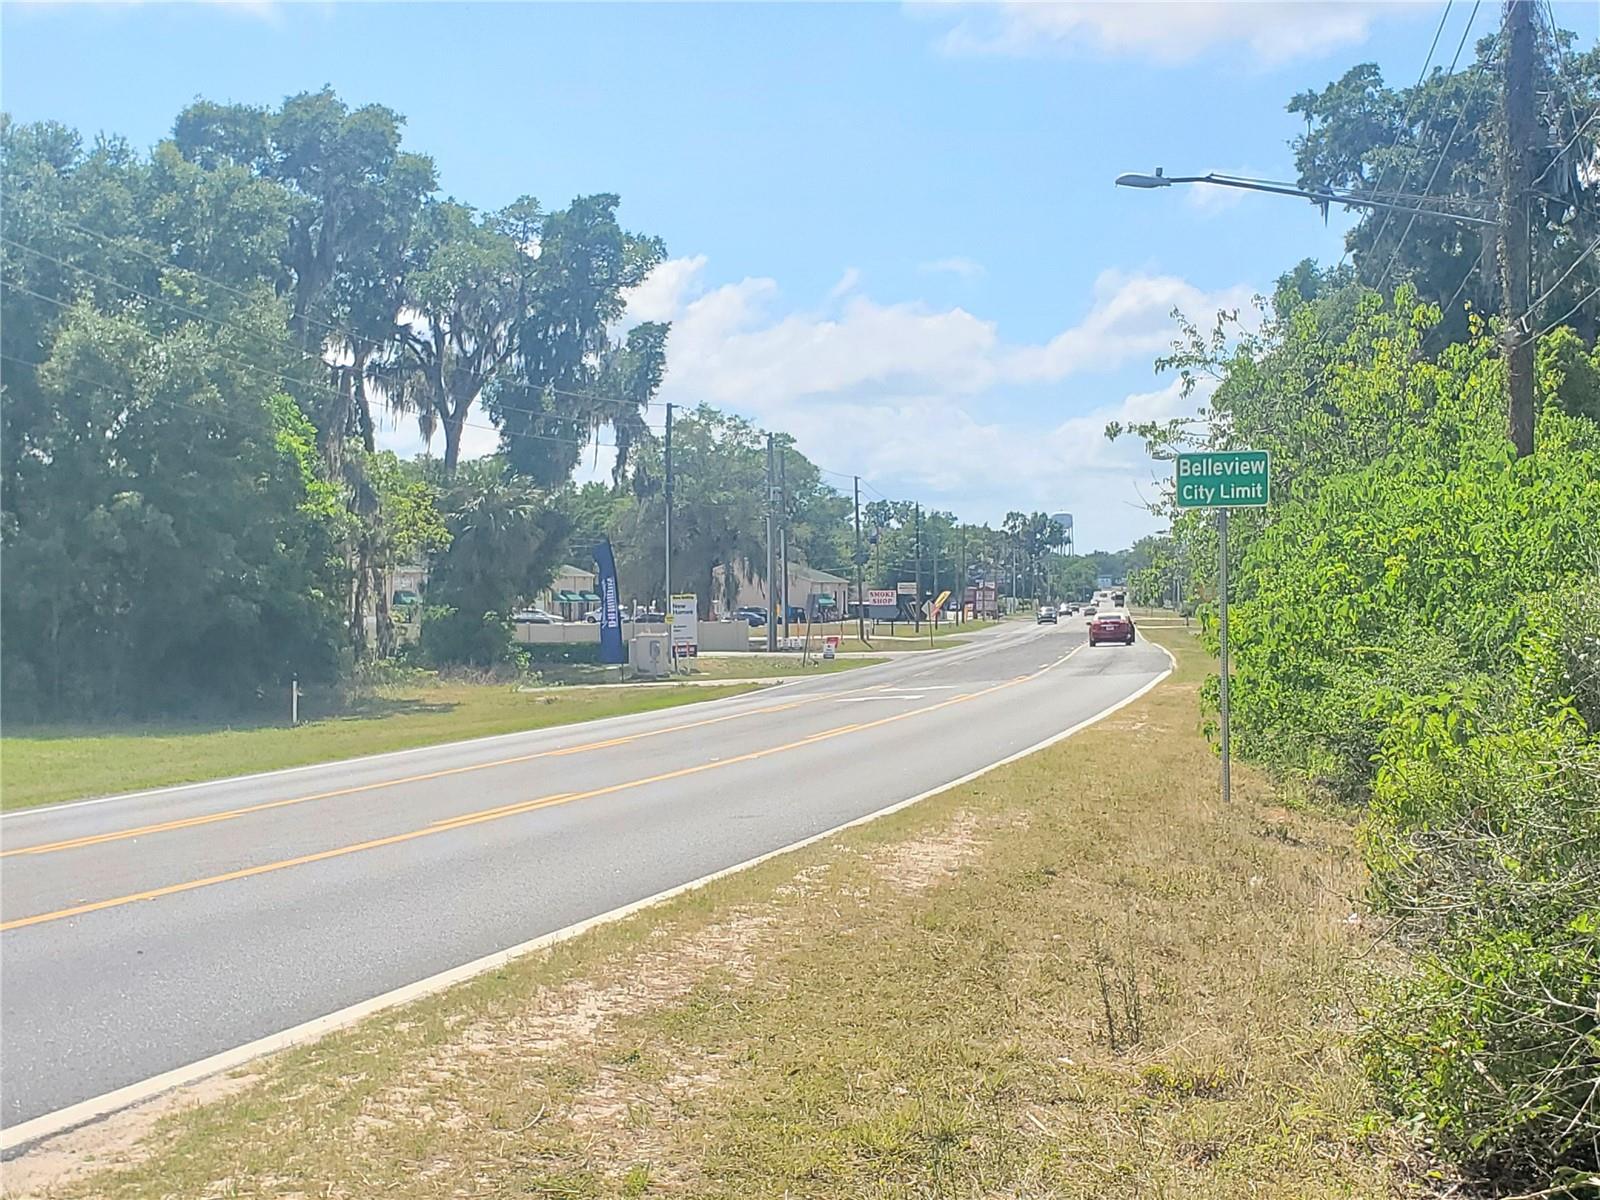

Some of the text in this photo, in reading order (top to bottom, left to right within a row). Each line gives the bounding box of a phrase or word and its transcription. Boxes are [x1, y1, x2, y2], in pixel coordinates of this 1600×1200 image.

[1179, 457, 1265, 477] Belleview
[1182, 483, 1263, 504] City Limit
